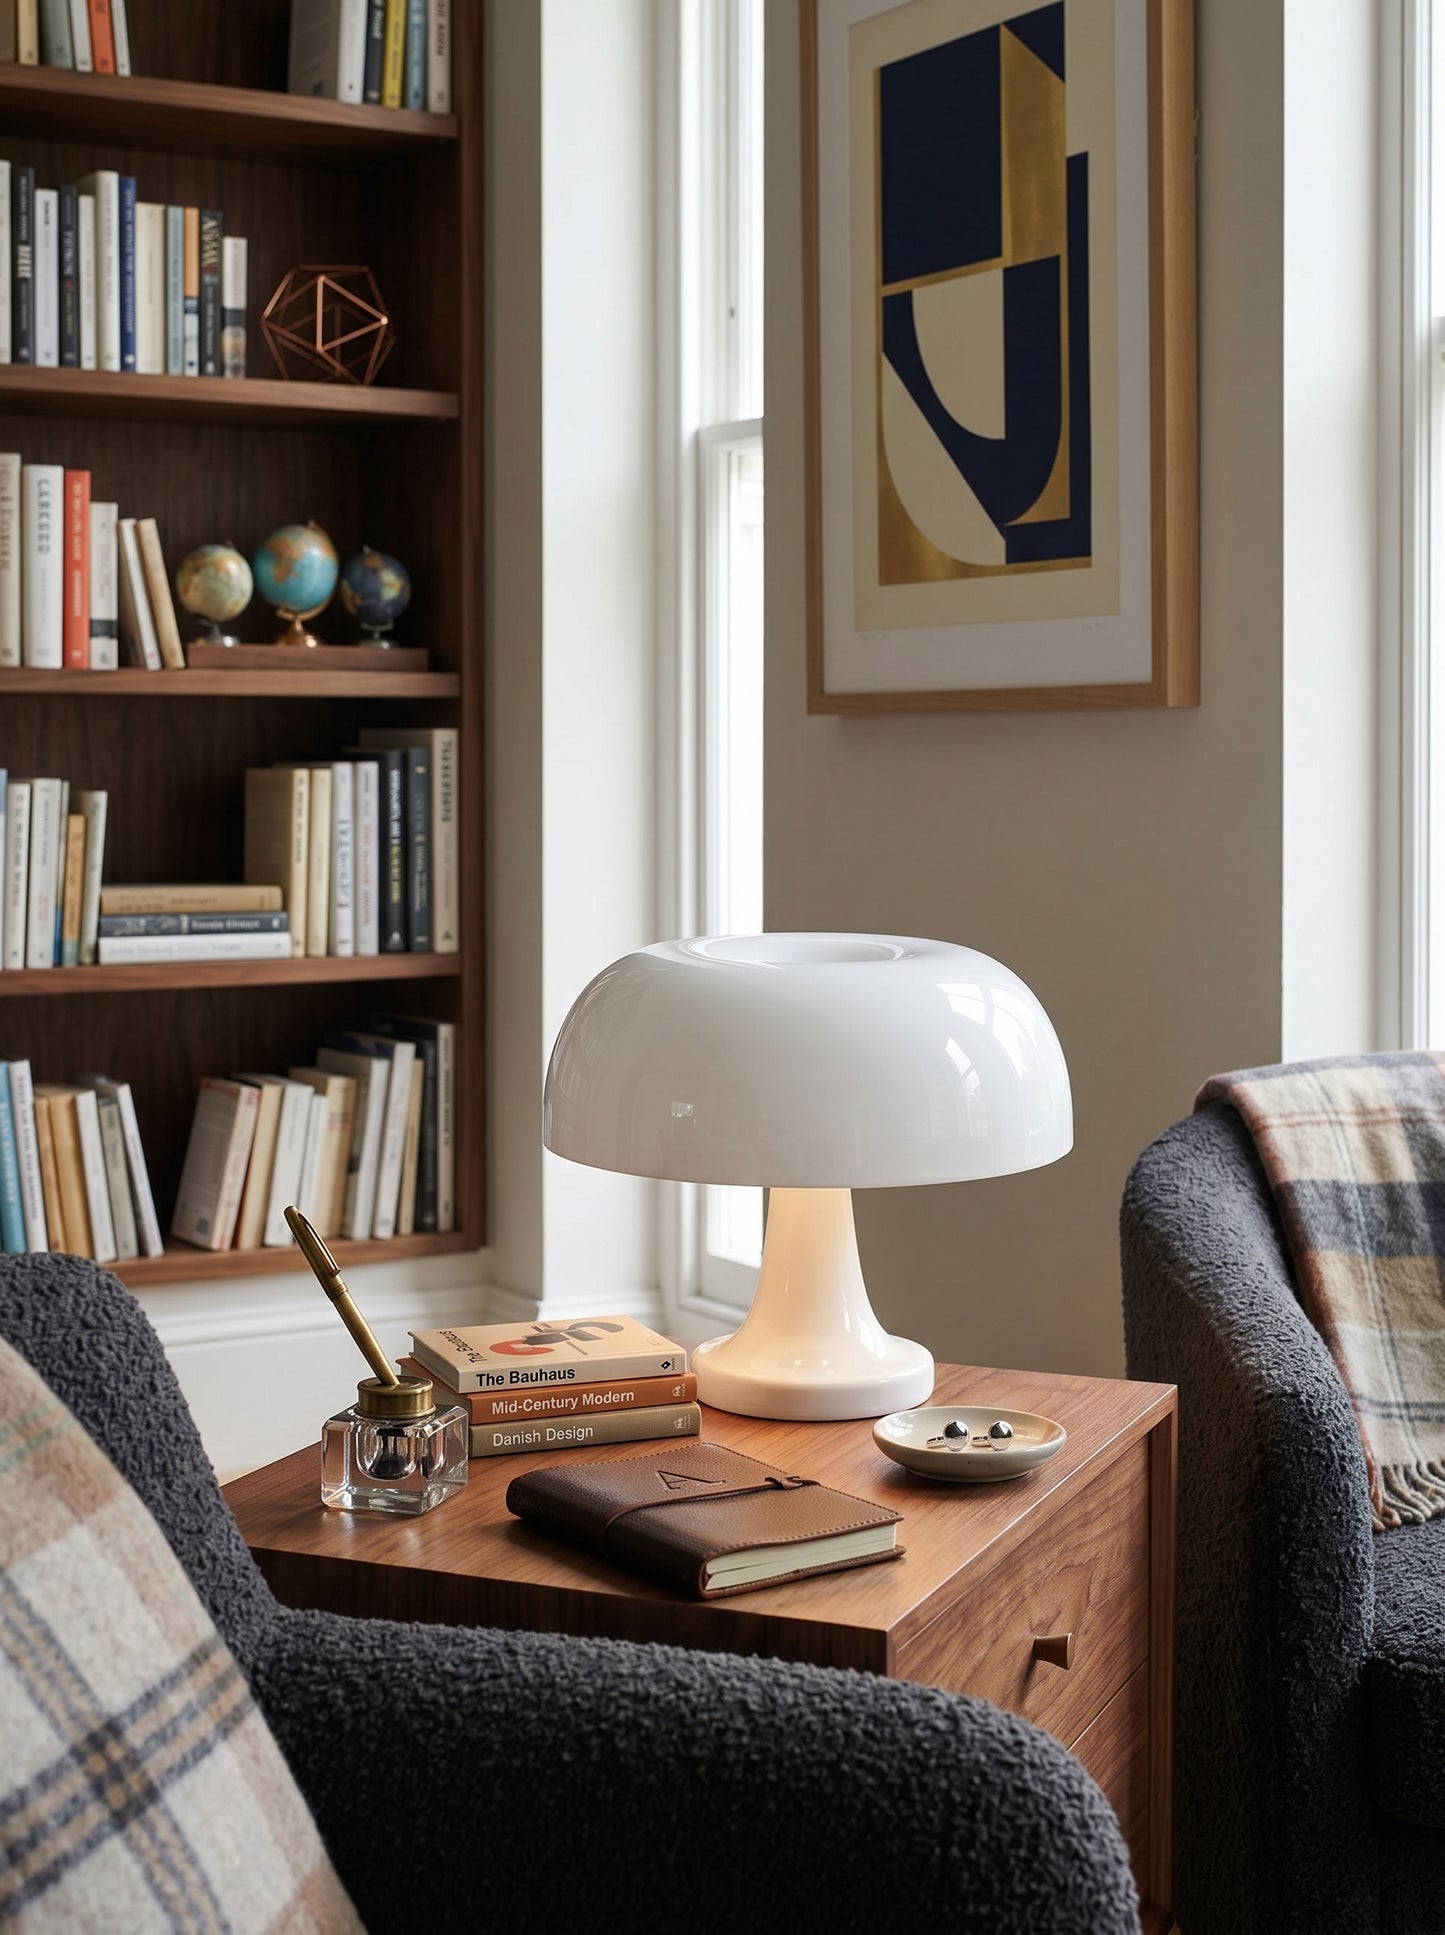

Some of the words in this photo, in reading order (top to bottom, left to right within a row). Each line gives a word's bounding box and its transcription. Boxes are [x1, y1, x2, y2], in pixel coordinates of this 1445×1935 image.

[476, 1373, 504, 1387] The
[509, 1368, 576, 1384] Bauhaus
[492, 1396, 579, 1415] Mid-Century
[582, 1391, 635, 1406] Modern
[493, 1429, 541, 1447] Danish
[546, 1425, 594, 1441] Design
[657, 1470, 726, 1490] A
